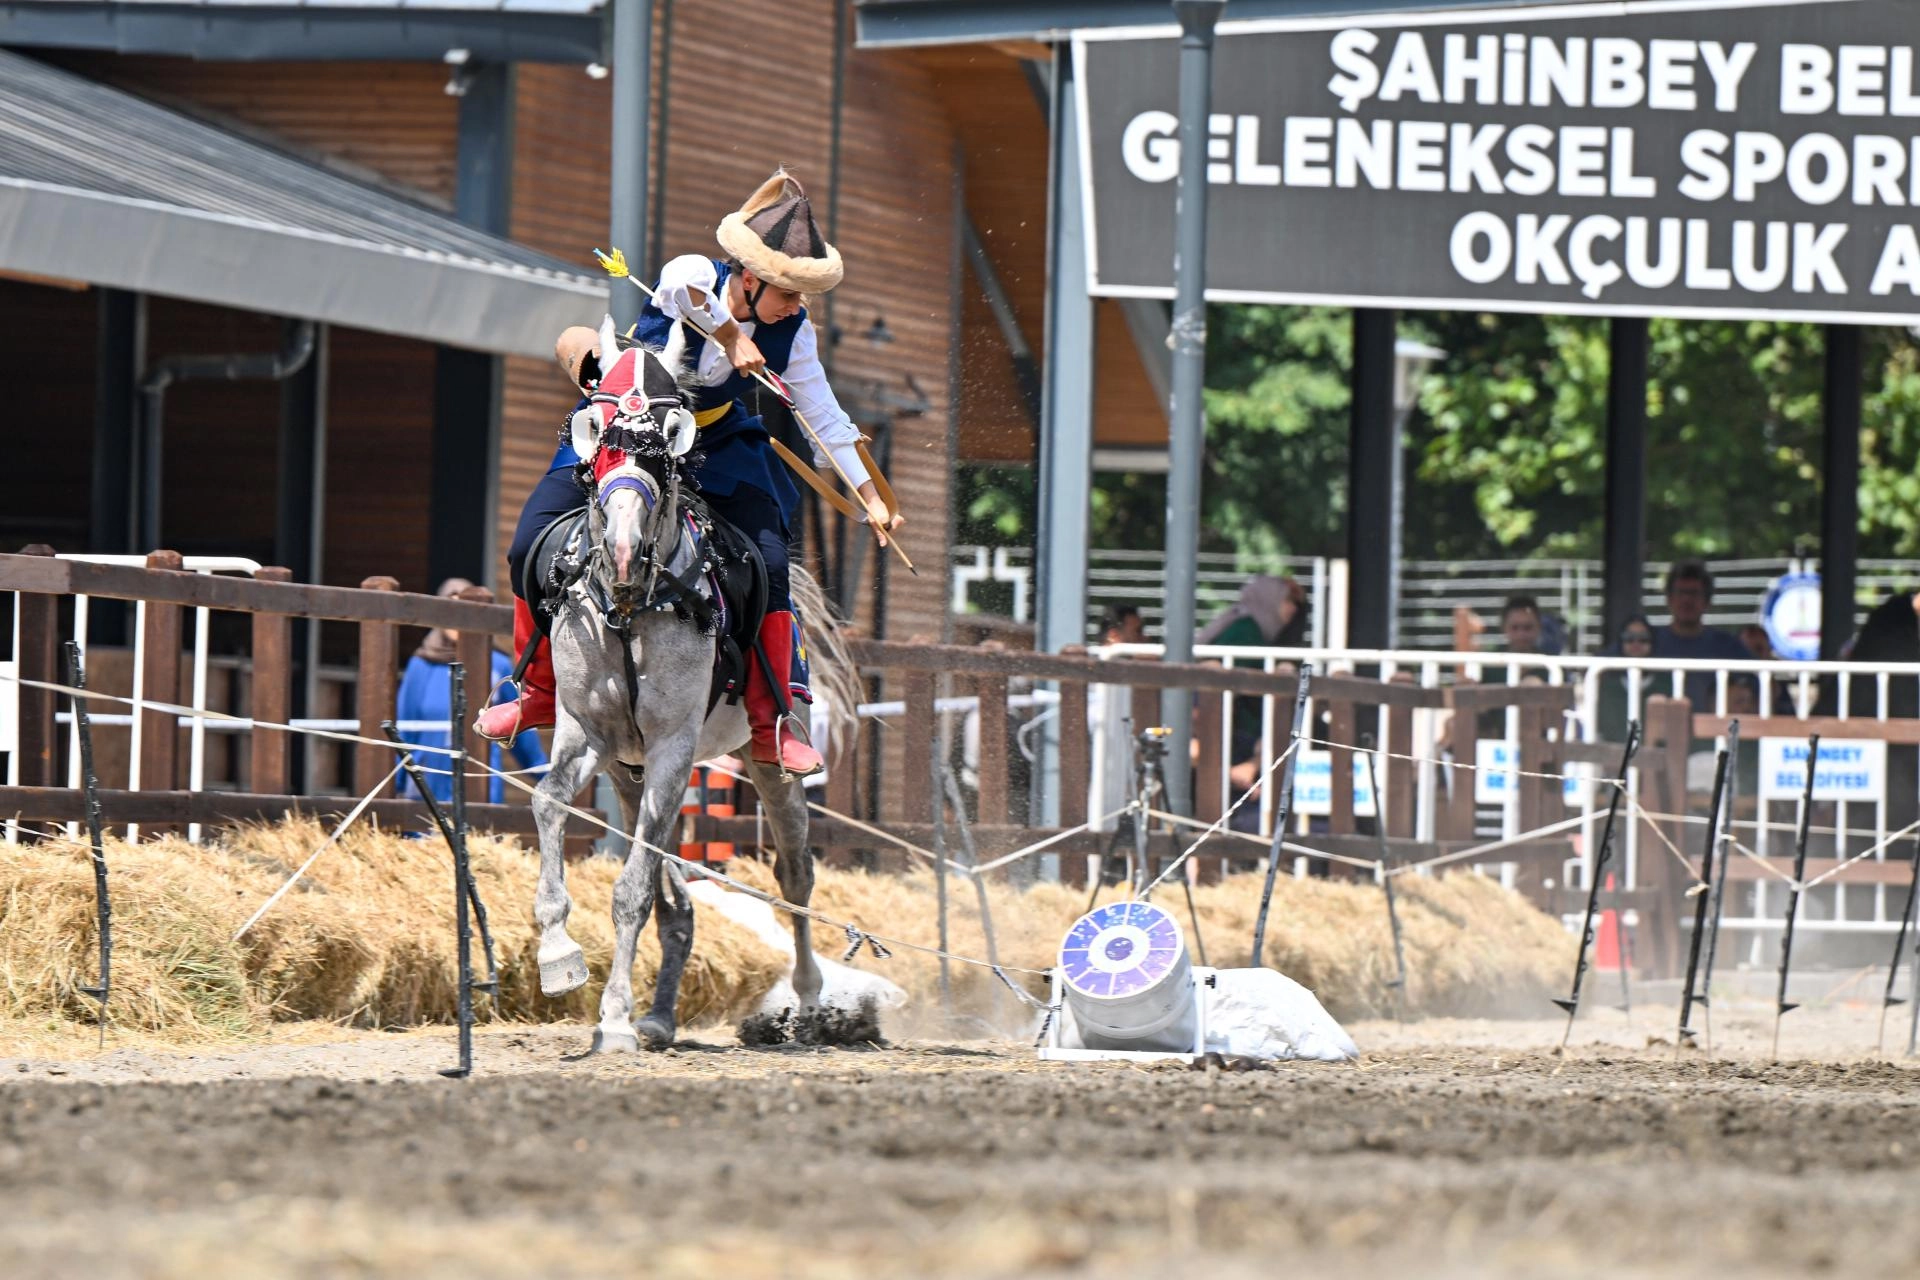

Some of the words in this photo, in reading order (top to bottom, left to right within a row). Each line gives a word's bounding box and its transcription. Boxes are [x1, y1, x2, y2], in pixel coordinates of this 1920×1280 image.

[1122, 110, 1656, 198] GELENEKSEL
[1678, 129, 1920, 206] SPOR
[1450, 211, 1848, 299] OKÇULUK
